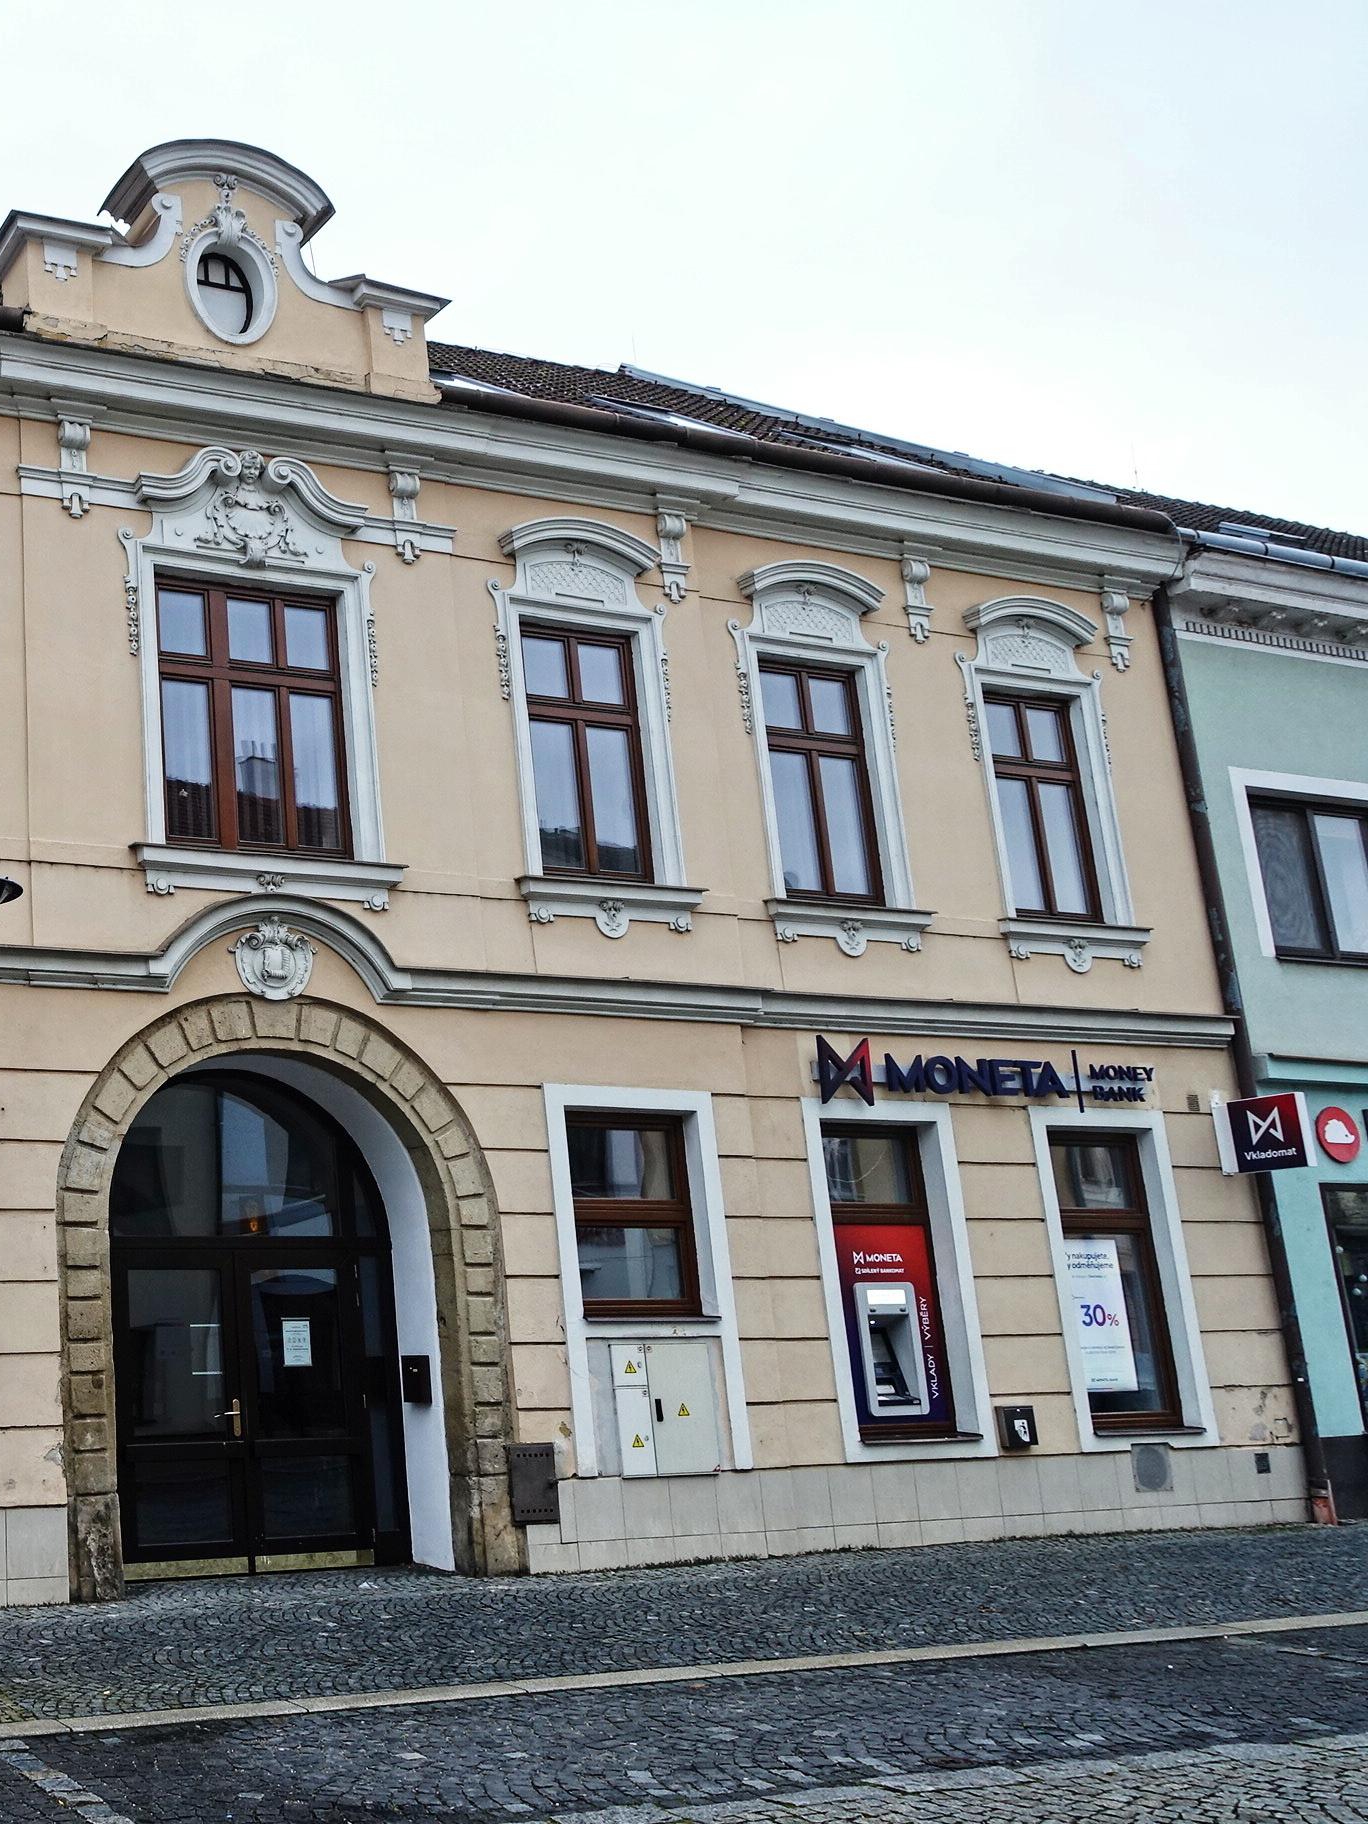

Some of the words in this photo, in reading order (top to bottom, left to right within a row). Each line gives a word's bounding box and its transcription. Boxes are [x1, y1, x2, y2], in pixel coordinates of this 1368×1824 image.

[884, 1053, 1070, 1099] MONETA
[1089, 1063, 1154, 1082] MONEY
[1092, 1085, 1146, 1102] BANK
[1244, 1147, 1297, 1161] Vkladomat
[865, 1253, 903, 1263] MONETA
[919, 1296, 932, 1341] VÝBĚRY
[1080, 1304, 1120, 1328] 30%
[926, 1354, 940, 1399] VKLADY
